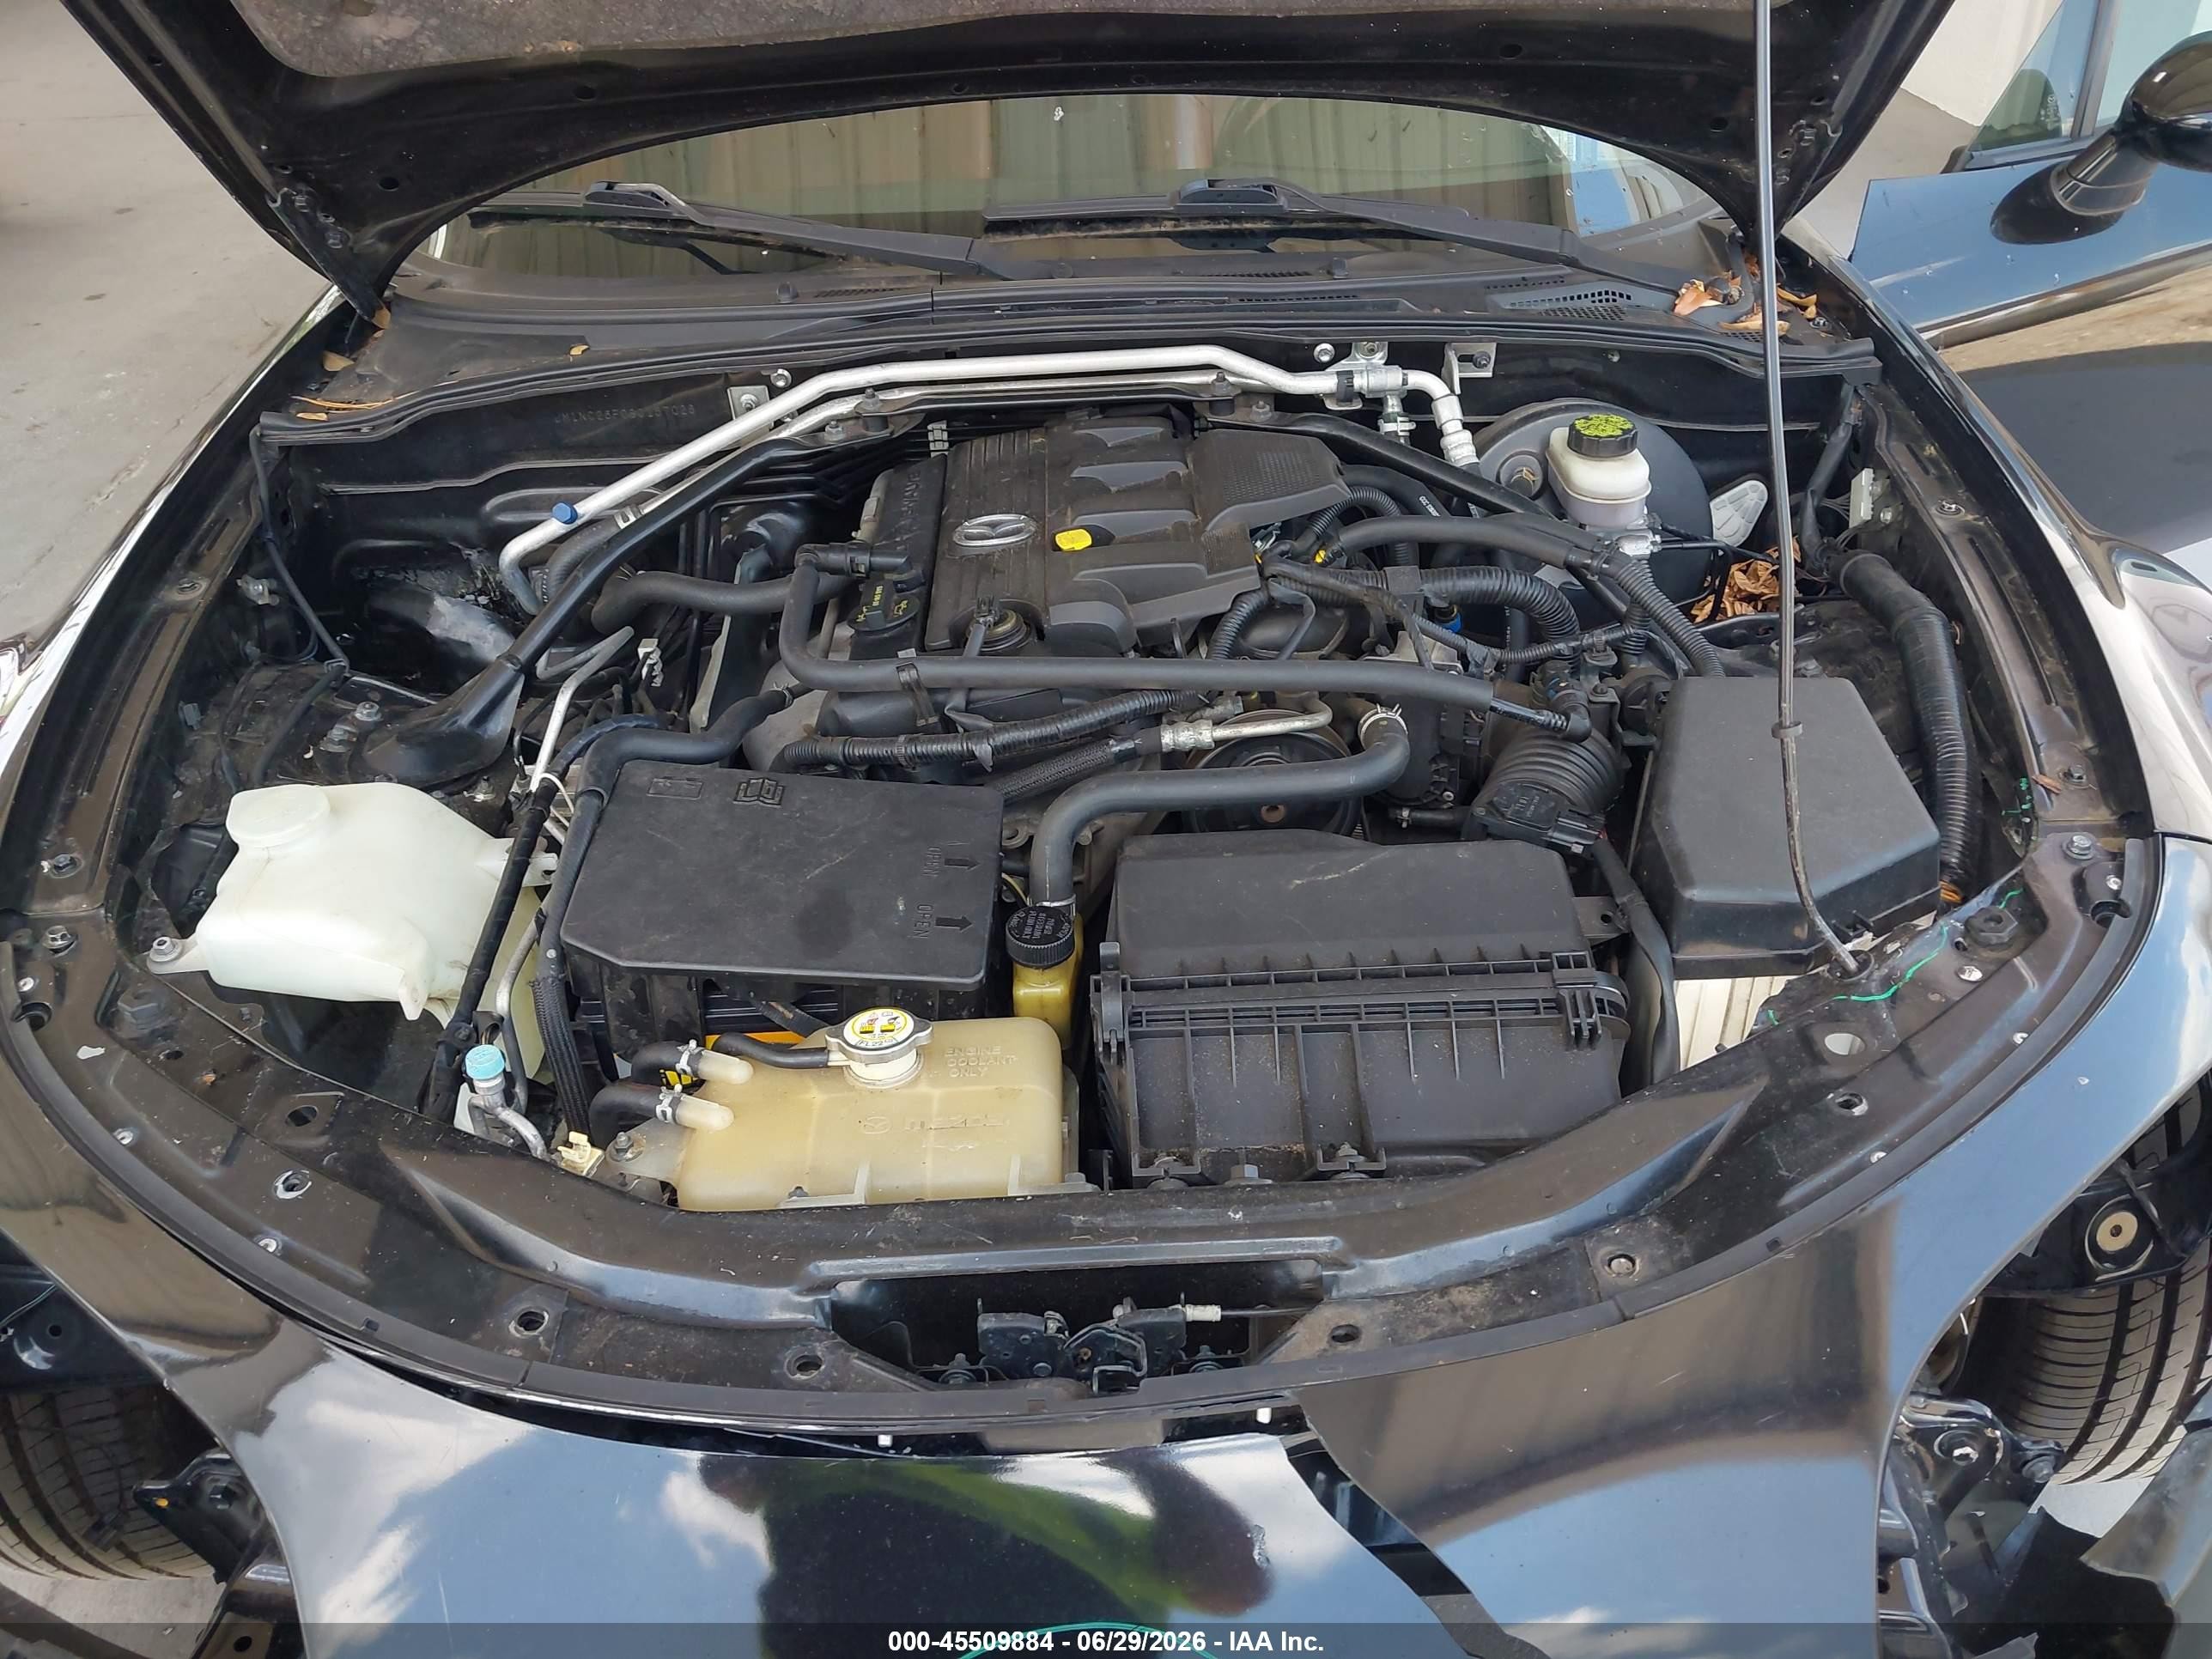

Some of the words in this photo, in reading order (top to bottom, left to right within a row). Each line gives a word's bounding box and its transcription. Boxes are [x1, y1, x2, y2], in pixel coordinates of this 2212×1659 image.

[914, 904, 934, 939] OPEN
[945, 1045, 1002, 1057] ENGINE
[947, 1054, 1017, 1066] COOLANT
[949, 1066, 988, 1078] ONLY
